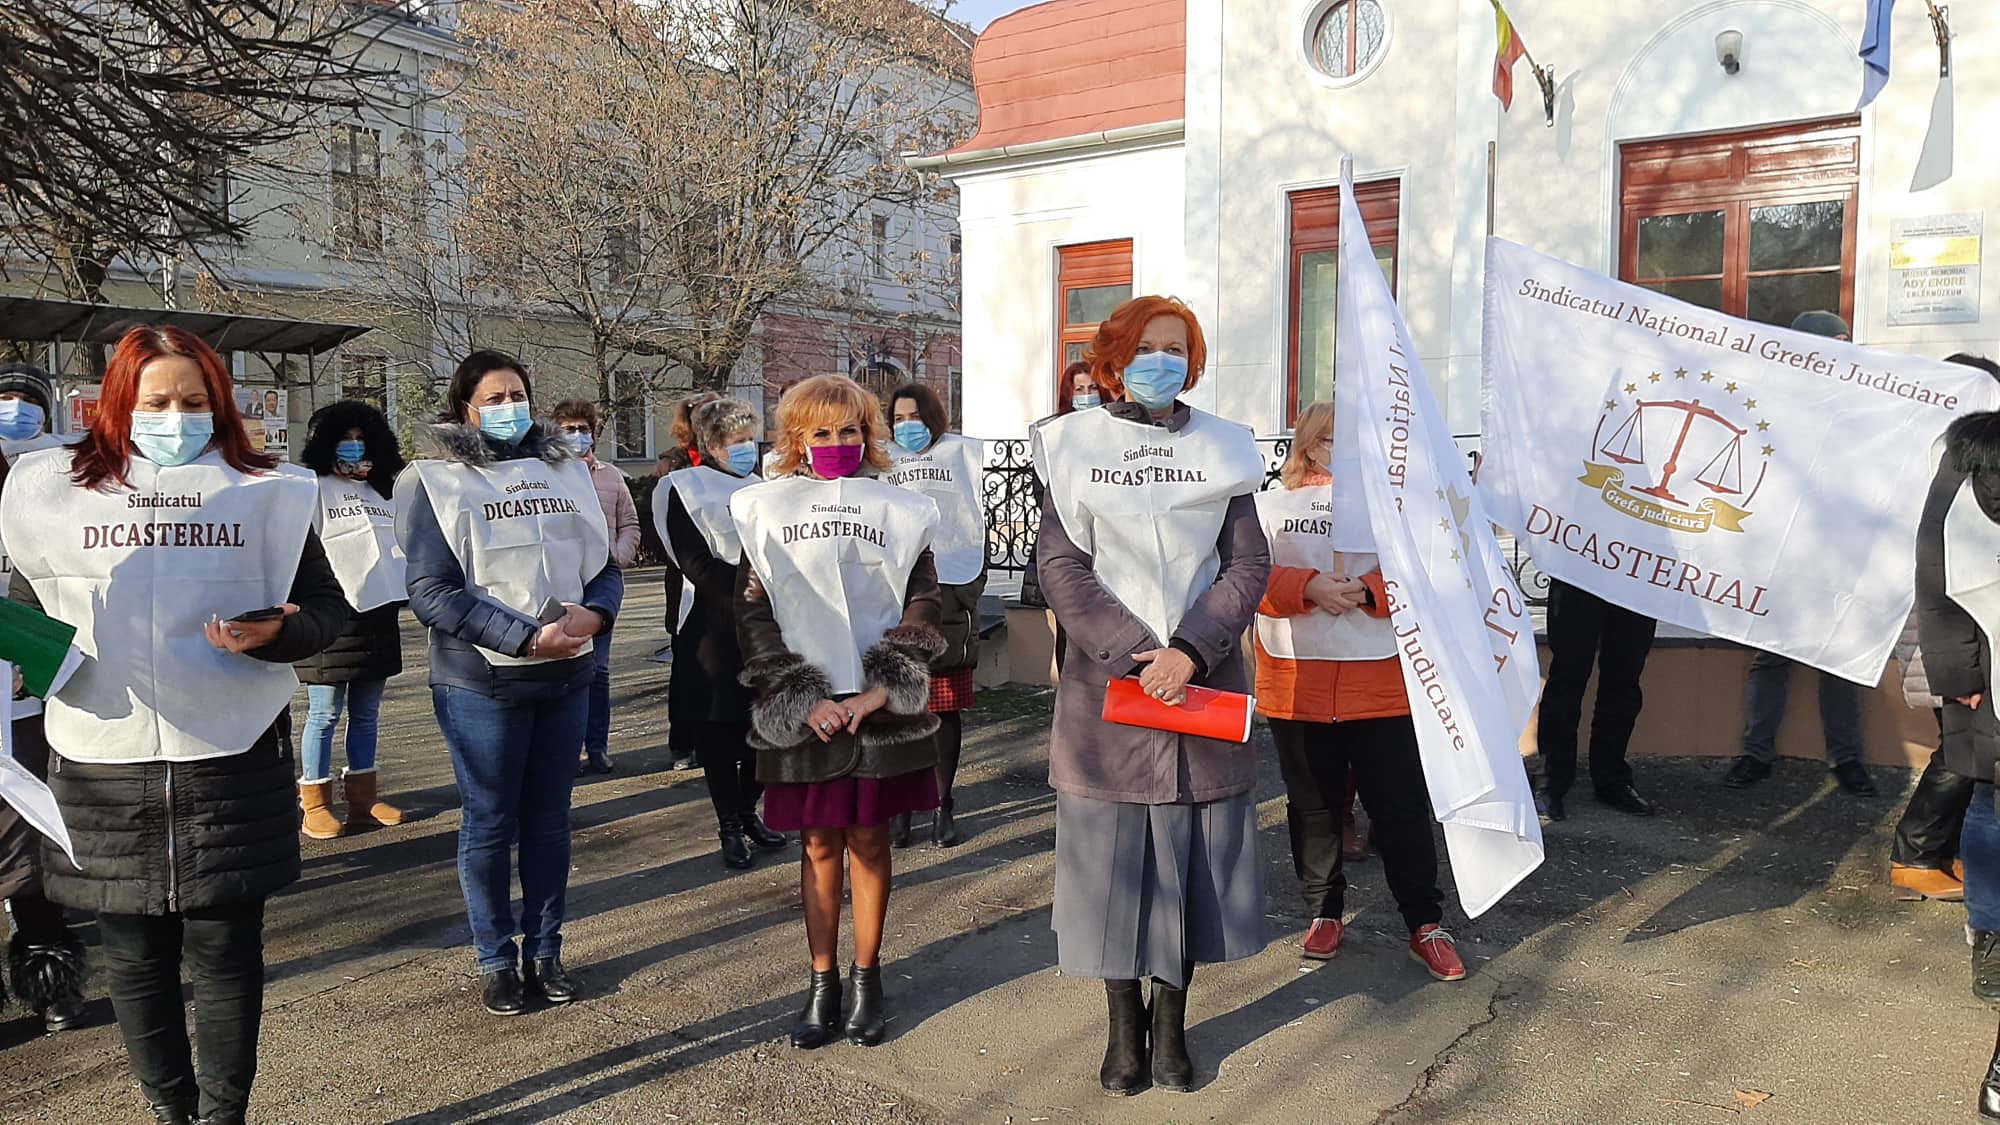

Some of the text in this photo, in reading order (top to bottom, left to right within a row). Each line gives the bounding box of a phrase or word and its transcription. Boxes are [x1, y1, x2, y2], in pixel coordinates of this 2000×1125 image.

[1903, 276, 1967, 288] ADY ENDRE
[1518, 278, 1959, 411] Sindicatul Național al Grefei Judiciare
[1123, 445, 1174, 462] Sindicatul
[887, 468, 953, 486] DICASTERIAL
[1090, 466, 1207, 486] DICASTERIAL
[506, 480, 550, 495] Sindicatul
[127, 492, 202, 509] Sindicatul
[483, 498, 581, 520] DICASTERIAL
[811, 504, 861, 515] Sindicatul
[1606, 489, 1705, 529] Grefa judiciară
[83, 523, 245, 550] DICASTERIAL
[783, 520, 886, 548] DICASTERIAL
[1525, 504, 1771, 617] DICASTERIAL
[1393, 622, 1465, 751] Judiciare
